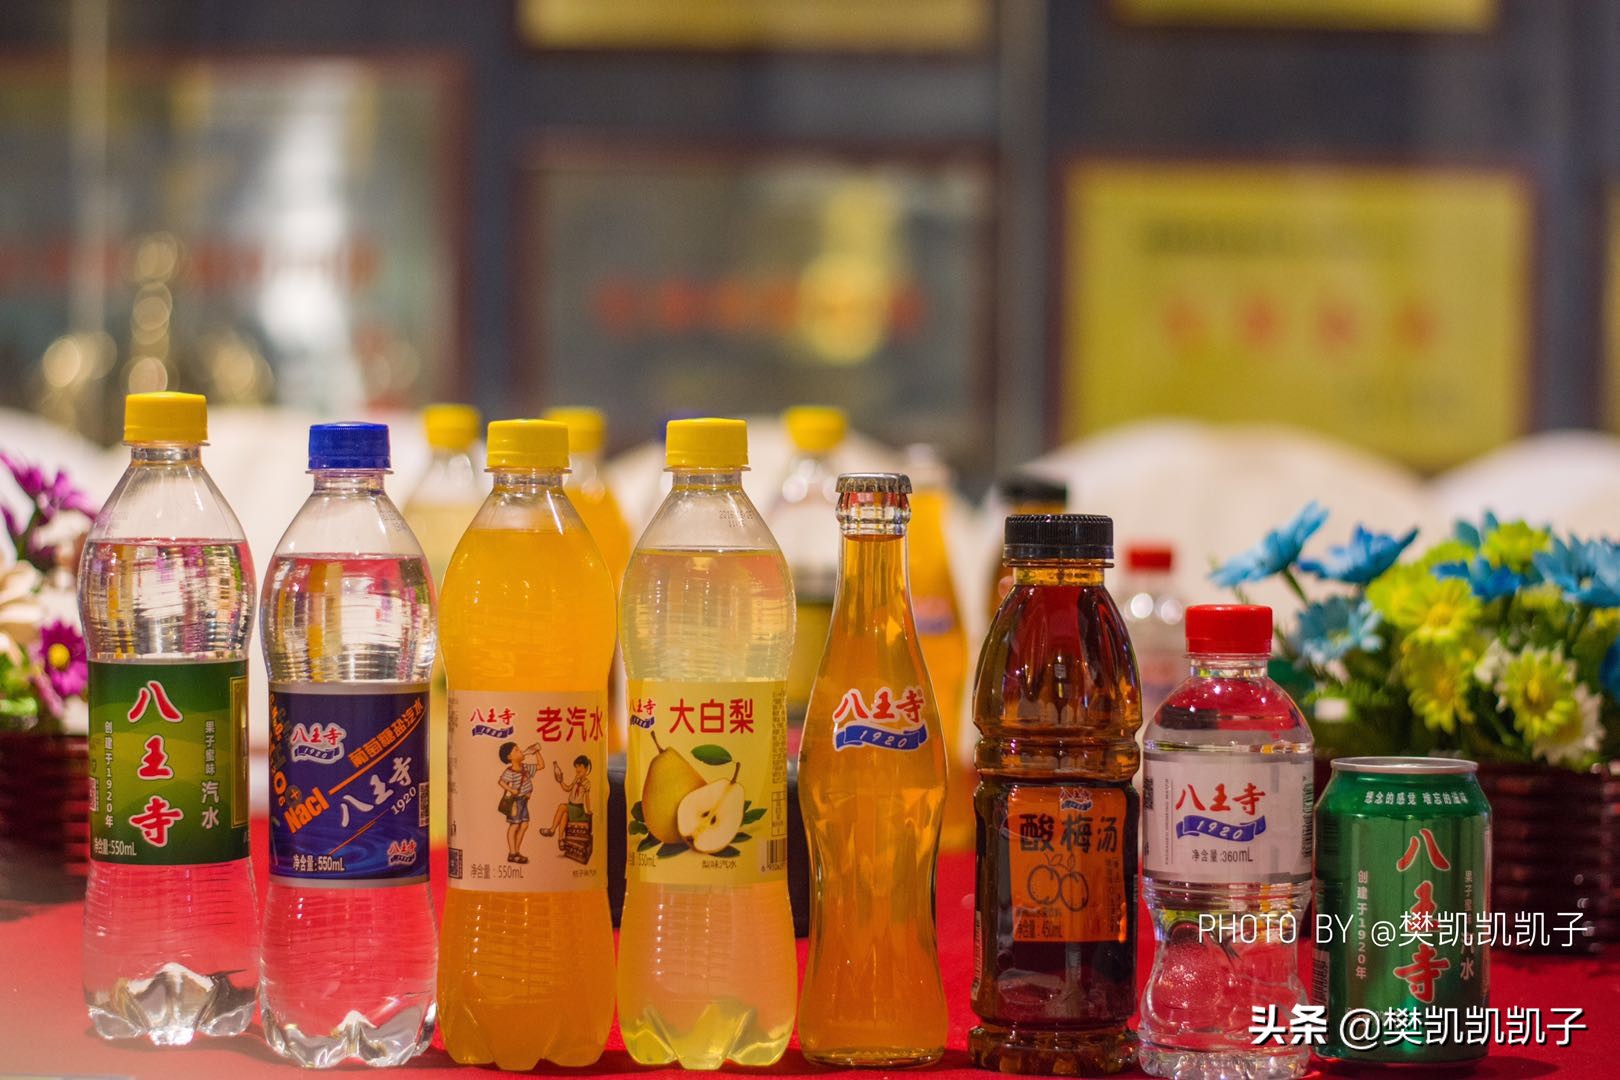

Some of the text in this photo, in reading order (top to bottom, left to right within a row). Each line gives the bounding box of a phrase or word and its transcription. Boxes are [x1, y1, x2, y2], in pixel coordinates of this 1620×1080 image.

[470, 708, 516, 725] 八王寺
[537, 706, 604, 742] 老汽水
[669, 698, 754, 734] 大白梨
[834, 689, 925, 724] 八王寺
[292, 726, 343, 746] 八王寺
[348, 697, 424, 769] 葡萄糖盐汽水
[859, 730, 907, 748] 1920
[128, 680, 184, 847] 八王寺
[304, 747, 328, 759] 1920
[104, 720, 114, 828] 创建于1920年
[341, 757, 413, 828] 八王寺
[391, 786, 417, 815] 1920
[1175, 782, 1266, 815] 八王寺
[1019, 813, 1118, 853] 酸梅汤
[1196, 820, 1244, 840] 1920
[293, 855, 345, 872] 净含量:550mL
[1192, 848, 1253, 863] 净含量:360mL
[1355, 870, 1369, 980] 创建于1920年
[1393, 828, 1451, 1004] 八王寺
